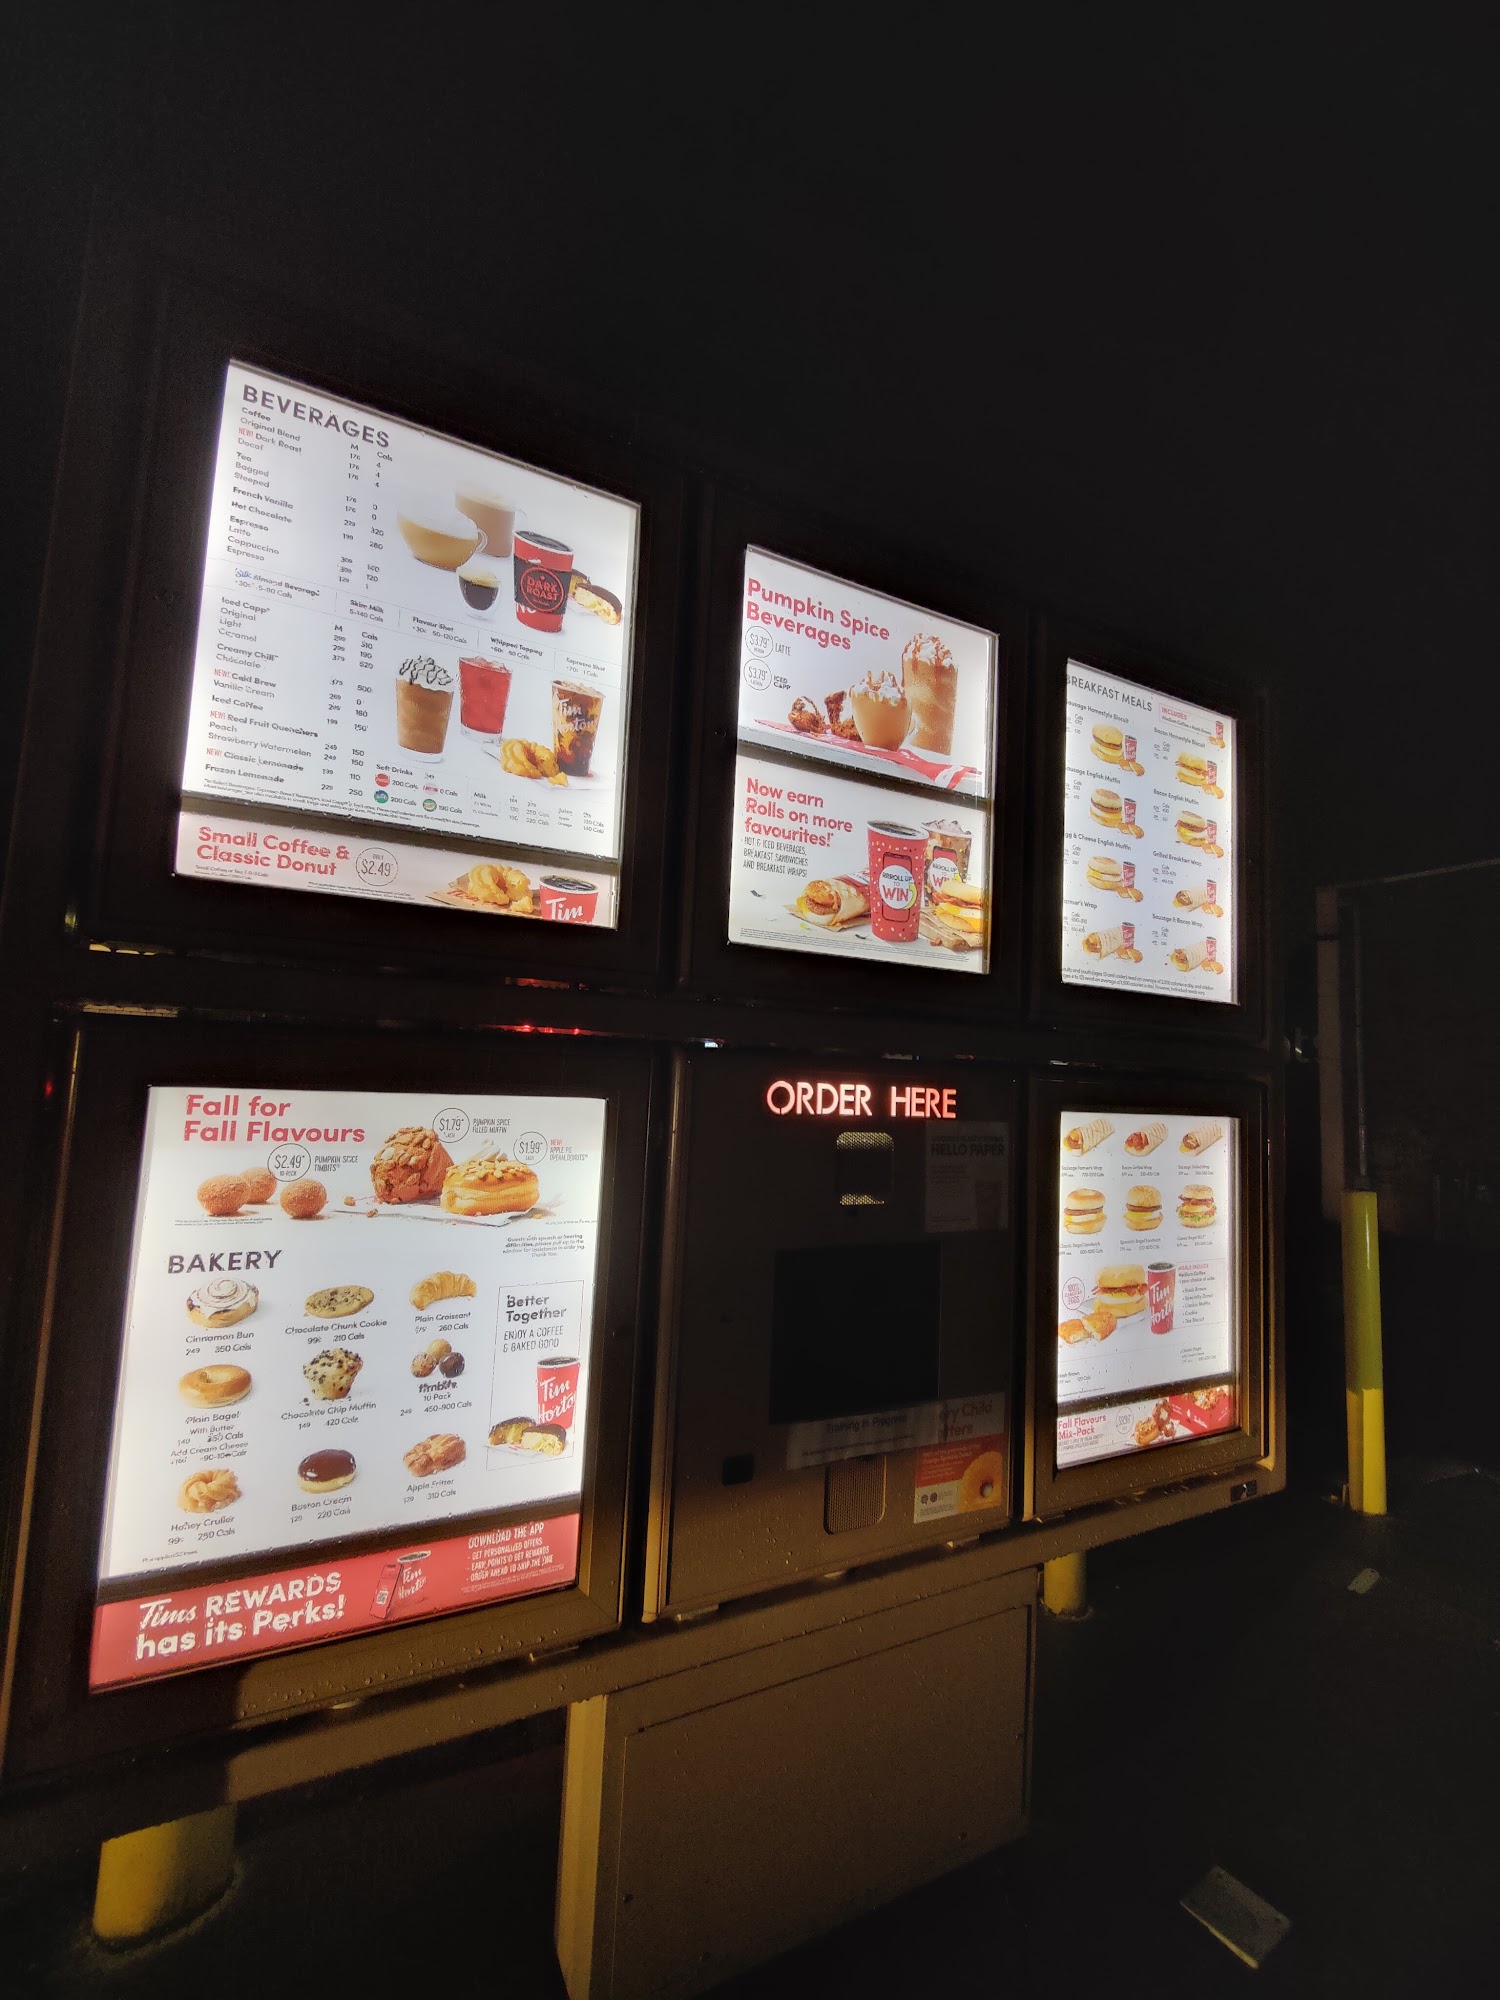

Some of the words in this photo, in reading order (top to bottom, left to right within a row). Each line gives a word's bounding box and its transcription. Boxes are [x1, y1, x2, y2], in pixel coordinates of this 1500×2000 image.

[241, 406, 271, 422] Coffee
[242, 384, 389, 448] BEVERAGES
[240, 417, 275, 434] Original
[277, 428, 301, 442] Blend
[238, 427, 254, 438] NEW!
[255, 432, 276, 446] Dark
[278, 440, 302, 453] Roast
[236, 451, 252, 462] Tea
[235, 461, 269, 478] Bagged
[234, 472, 270, 488] Steeped
[232, 486, 263, 501] French
[264, 495, 294, 510] Vanilla
[231, 501, 247, 511] Hot
[248, 506, 293, 524] Chocolate
[230, 516, 269, 532] Espresso
[226, 545, 265, 562] Espresso
[227, 535, 280, 555] Cappuccino
[527, 575, 559, 593] DARK
[221, 596, 241, 607] Iced
[526, 586, 559, 601] ROAST
[220, 607, 256, 622] Original
[747, 577, 834, 623] Pumpkin
[840, 609, 890, 641] Spice
[219, 617, 242, 628] Light
[334, 624, 343, 632] M
[746, 600, 852, 650] Beverages
[216, 643, 252, 658] Creamy
[775, 643, 791, 656] LATTE
[213, 668, 231, 678] NEW!
[254, 677, 277, 688] Brew
[773, 675, 788, 684] ICED
[212, 694, 231, 704] Iced
[233, 699, 264, 712] Coffee
[559, 698, 582, 716] Tim
[1121, 694, 1153, 712] MEALS
[1161, 706, 1188, 721] INCLUDES
[209, 721, 238, 733] Peach
[227, 714, 248, 725] Real
[249, 718, 270, 729] Fruit
[271, 722, 319, 738] Quenchers
[208, 732, 259, 749] Strawberry
[260, 740, 312, 757] Watermelon
[206, 747, 222, 757] NEW!
[224, 752, 256, 764] Classic
[258, 756, 304, 772] Lemonade
[205, 763, 236, 776] Frozen
[238, 769, 285, 784] Lemonade
[745, 777, 784, 800] Now
[787, 790, 824, 809] earn
[744, 797, 785, 819] Rolls
[788, 809, 809, 824] on
[812, 813, 854, 833] more
[198, 826, 258, 847] Small
[263, 835, 331, 858] Coffee
[336, 845, 350, 861] &
[763, 839, 775, 850] ICED
[196, 845, 271, 867] Classic
[276, 853, 337, 876] Donut
[743, 848, 774, 861] BREAKFAST
[743, 859, 755, 870] AND
[756, 861, 786, 874] BREAKFAST
[882, 884, 909, 902] WIN
[545, 897, 584, 920] Tim
[185, 1094, 240, 1116] Fall
[248, 1096, 291, 1117] for
[766, 1080, 873, 1117] ORDER
[890, 1085, 957, 1119] HERE
[472, 1118, 496, 1127] PUMPKIN
[496, 1118, 511, 1126] SPICE
[472, 1125, 488, 1134] FILLED
[489, 1126, 507, 1134] MUFFIN
[184, 1120, 237, 1142] Fall
[246, 1120, 366, 1143] Flavours
[931, 1143, 968, 1156] HELLO
[970, 1143, 1005, 1156] PAPER
[314, 1155, 341, 1164] PUMPKIN
[167, 1249, 284, 1274] BAKERY
[1067, 1295, 1082, 1305] EGGS
[1149, 1280, 1170, 1305] Tim
[506, 1294, 550, 1309] Better
[414, 1315, 434, 1324] Plain
[435, 1311, 471, 1321] Croissant
[505, 1307, 568, 1325] Together
[284, 1324, 329, 1336] Chocolate
[330, 1321, 358, 1331] Chunk
[359, 1319, 388, 1328] Cookie
[453, 1322, 469, 1331] Cals
[503, 1329, 528, 1341] ENJOY
[529, 1328, 535, 1338] A
[536, 1325, 564, 1337] COFFEE
[185, 1333, 235, 1345] Cinnamon
[236, 1331, 255, 1340] Bun
[502, 1342, 509, 1353] &
[510, 1339, 537, 1352] BAKED
[433, 1392, 452, 1401] Pack
[539, 1376, 570, 1402] Tim
[327, 1406, 348, 1416] Chip
[349, 1402, 377, 1412] Muffin
[456, 1400, 473, 1409] Cals
[961, 1399, 993, 1417] Child
[185, 1415, 210, 1425] Plain
[212, 1412, 241, 1422] Bagel
[826, 1420, 860, 1434] Training
[872, 1414, 907, 1428] Progress
[1058, 1418, 1073, 1430] Fall
[1074, 1414, 1107, 1427] Flavours
[1058, 1425, 1096, 1440] Mix-Pack
[170, 1448, 188, 1458] Add
[189, 1444, 217, 1455] Cream
[406, 1482, 430, 1493] Apple
[291, 1501, 321, 1512] Boston
[468, 1529, 512, 1549] DOWNLOAD
[513, 1525, 528, 1540] THE
[529, 1522, 545, 1536] APP
[472, 1550, 483, 1561] GET
[523, 1537, 543, 1549] OFFERS
[487, 1556, 507, 1568] POINTS
[514, 1552, 524, 1562] GET
[525, 1545, 550, 1559] REWARDS
[402, 1566, 422, 1585] Tim
[470, 1569, 489, 1582] ORDER
[531, 1558, 541, 1567] THE
[139, 1597, 197, 1630] Tims
[204, 1571, 342, 1618] REWARDS
[135, 1631, 196, 1661] has
[205, 1616, 245, 1647] its
[252, 1594, 347, 1636] Perks!
